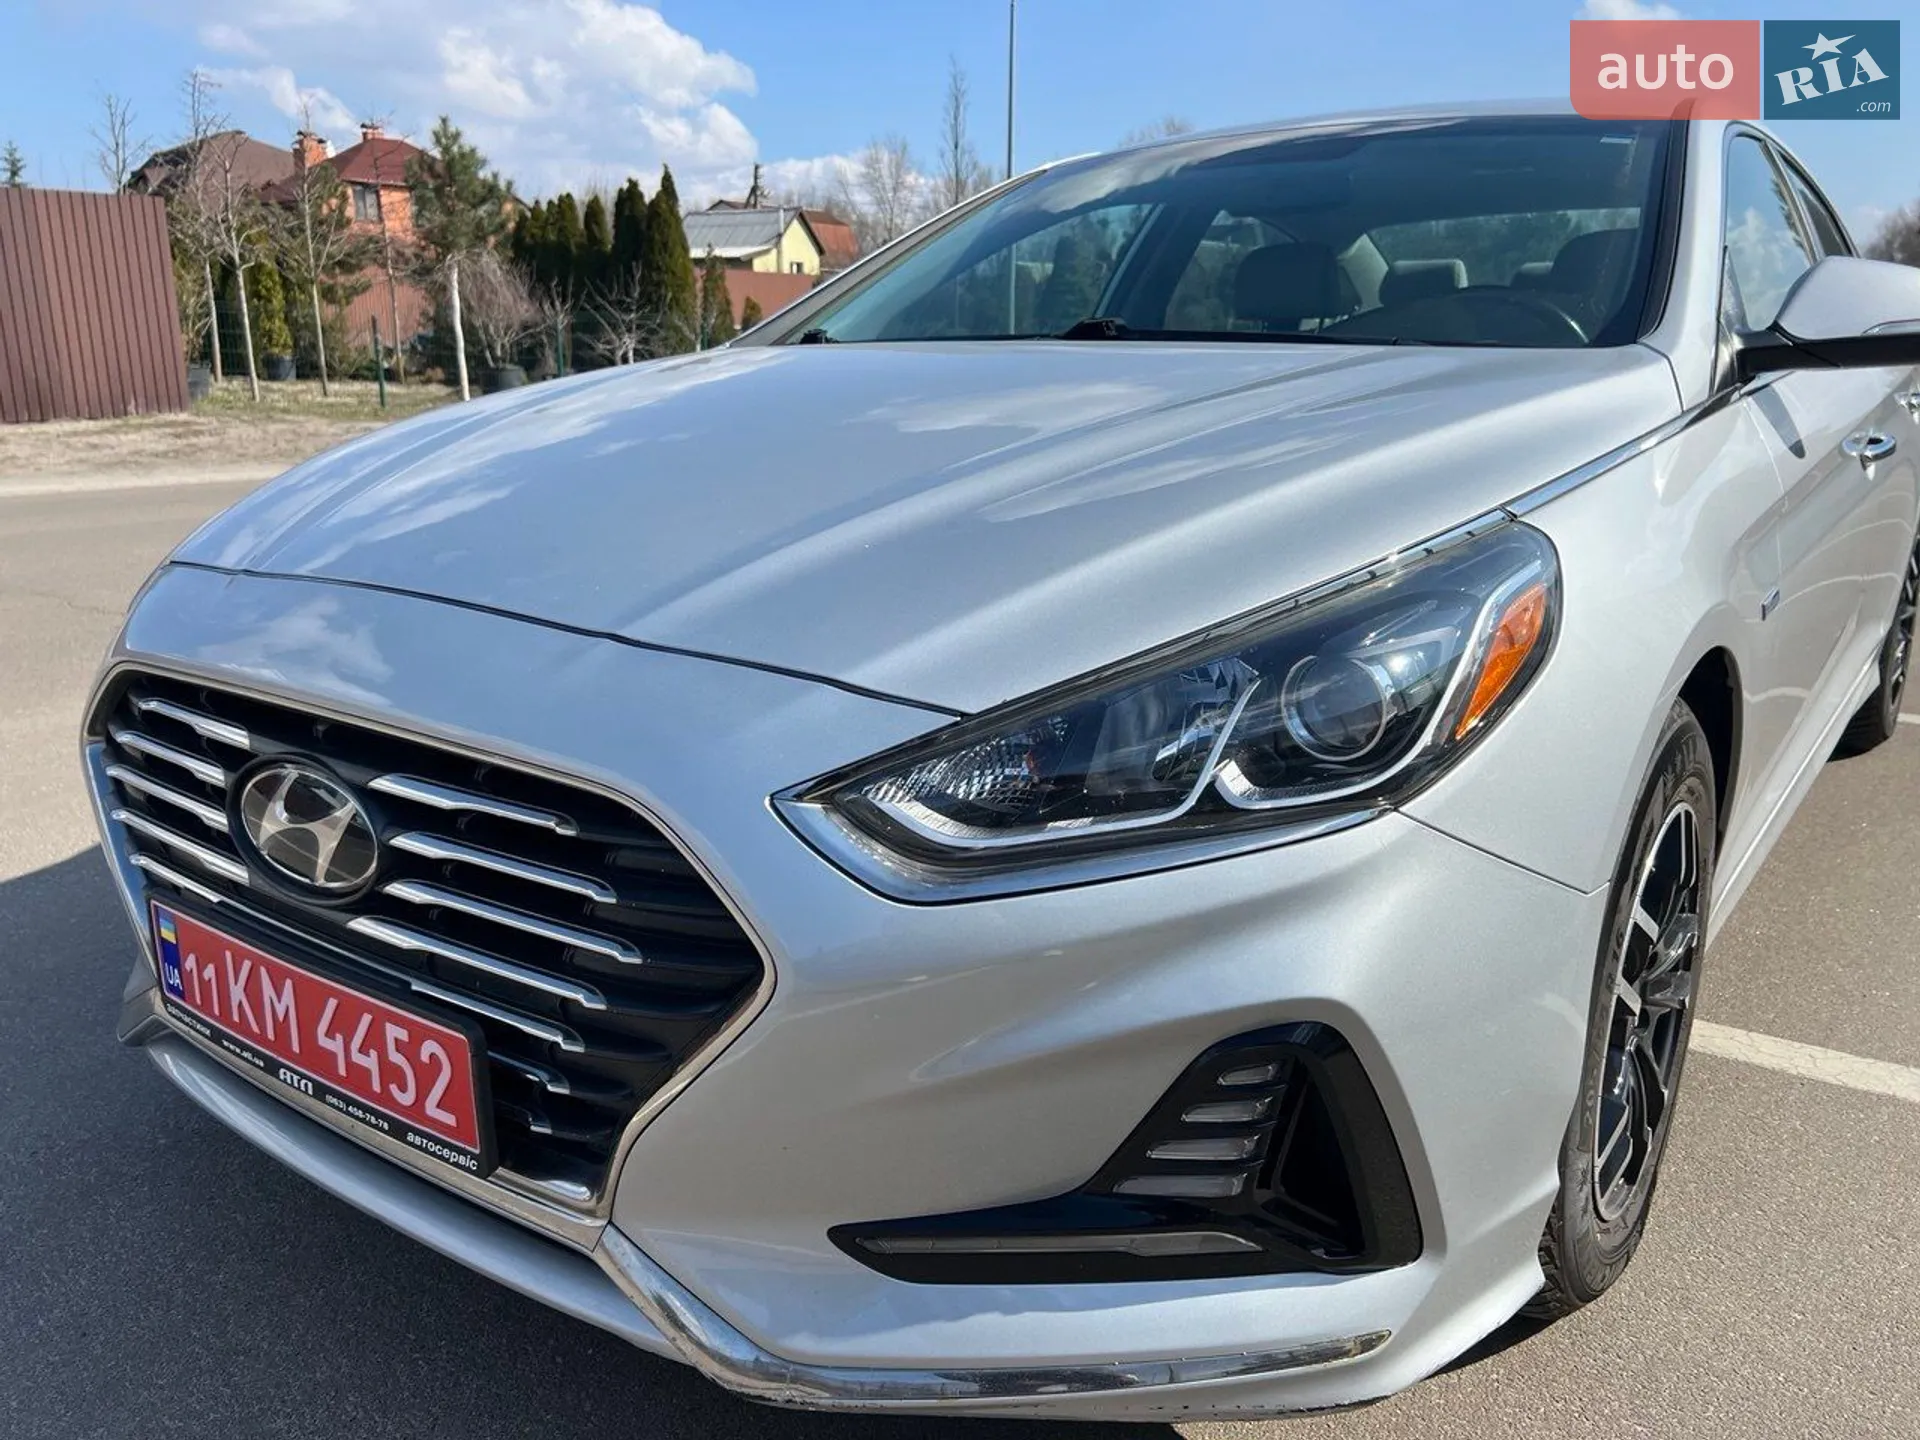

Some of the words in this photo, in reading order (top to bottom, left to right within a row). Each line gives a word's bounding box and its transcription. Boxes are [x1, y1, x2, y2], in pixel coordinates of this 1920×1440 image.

[164, 965, 183, 991] UA
[316, 997, 458, 1128] 4452
[406, 1131, 479, 1171] автосервіс
